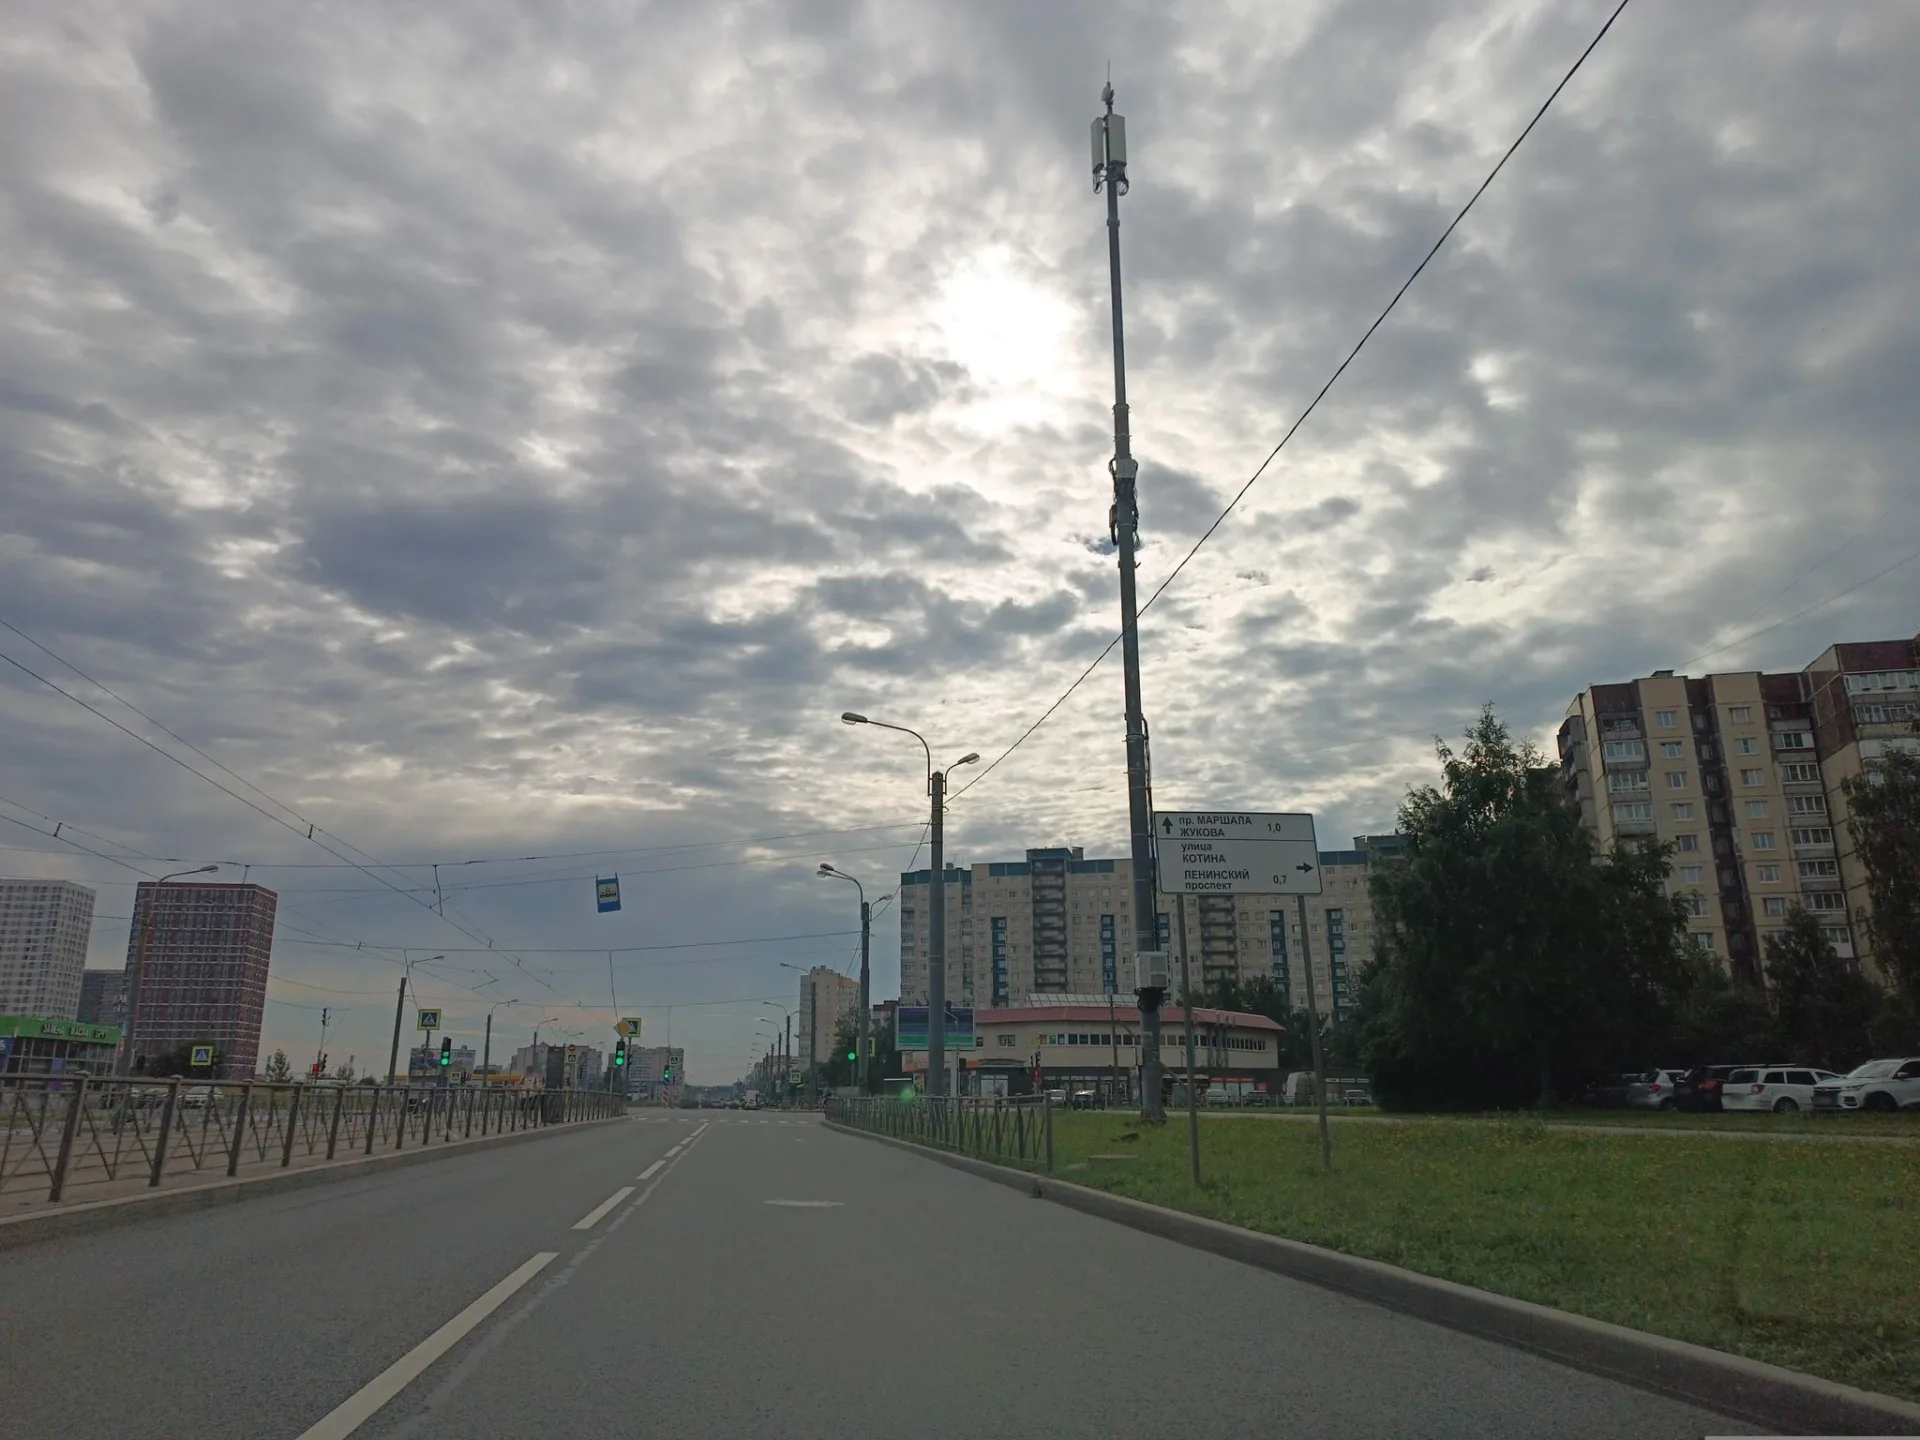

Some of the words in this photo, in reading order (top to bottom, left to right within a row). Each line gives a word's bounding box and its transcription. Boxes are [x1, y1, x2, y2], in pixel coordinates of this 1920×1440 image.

[1179, 816, 1194, 826] пр.
[1197, 815, 1252, 825] МАРШАЛА
[1180, 827, 1225, 837] ЖУКОВА
[1267, 823, 1281, 833] 1,0
[1181, 843, 1212, 852] улица
[1182, 854, 1226, 863] КОТИНА
[1184, 868, 1250, 880] ЛЕНИНСКИЙ
[1273, 875, 1287, 885] 0,7
[1185, 882, 1232, 891] проспект
